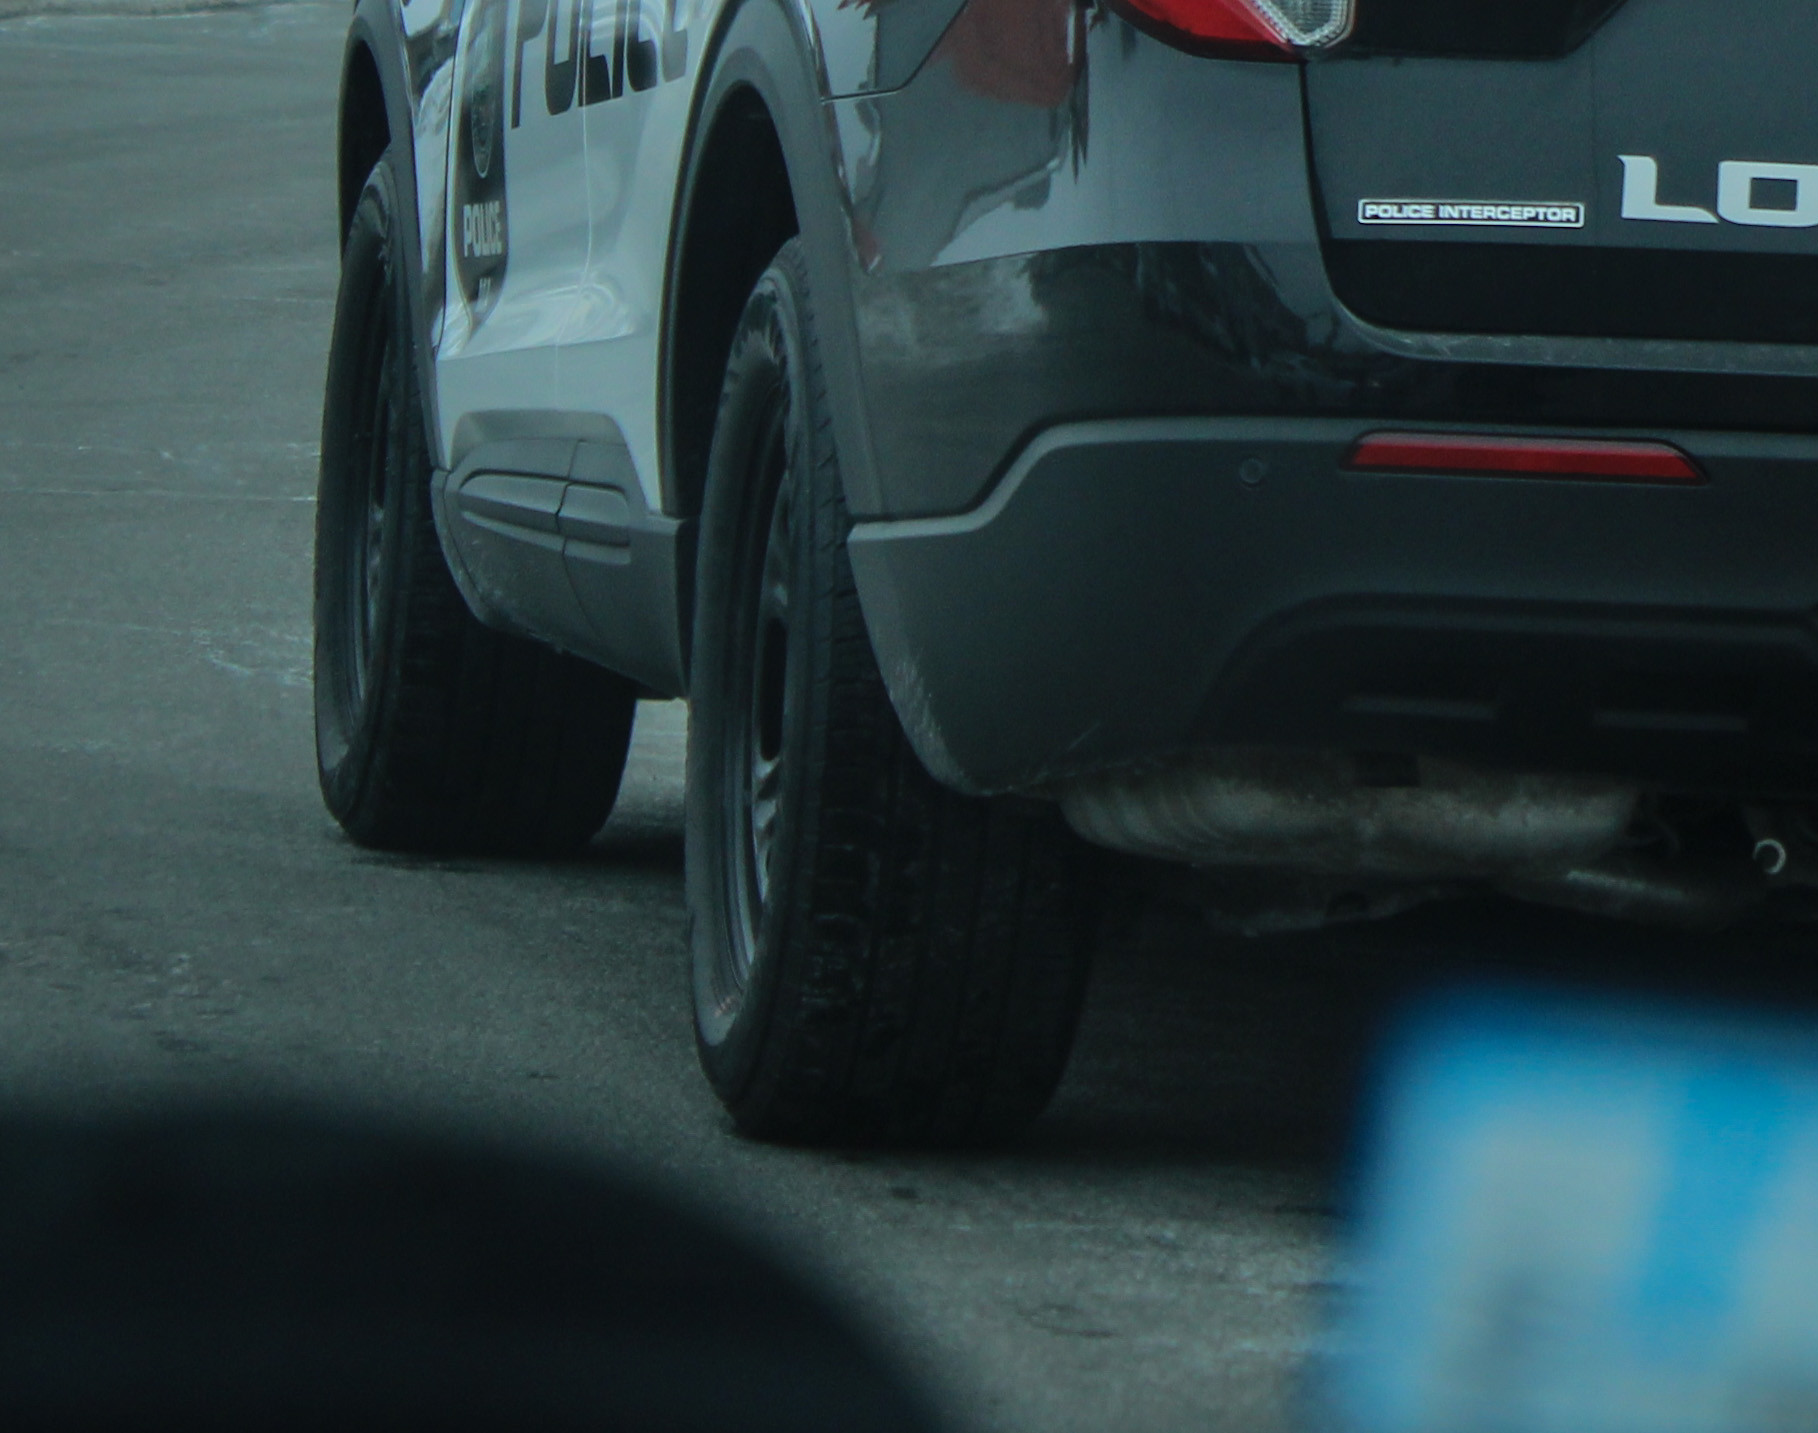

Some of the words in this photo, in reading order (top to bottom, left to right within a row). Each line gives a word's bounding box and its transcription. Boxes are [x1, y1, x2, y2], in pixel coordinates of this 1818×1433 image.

[463, 203, 502, 259] POLICE
[1364, 202, 1435, 219] POLICE
[1438, 204, 1577, 223] INTERCEPTOR
